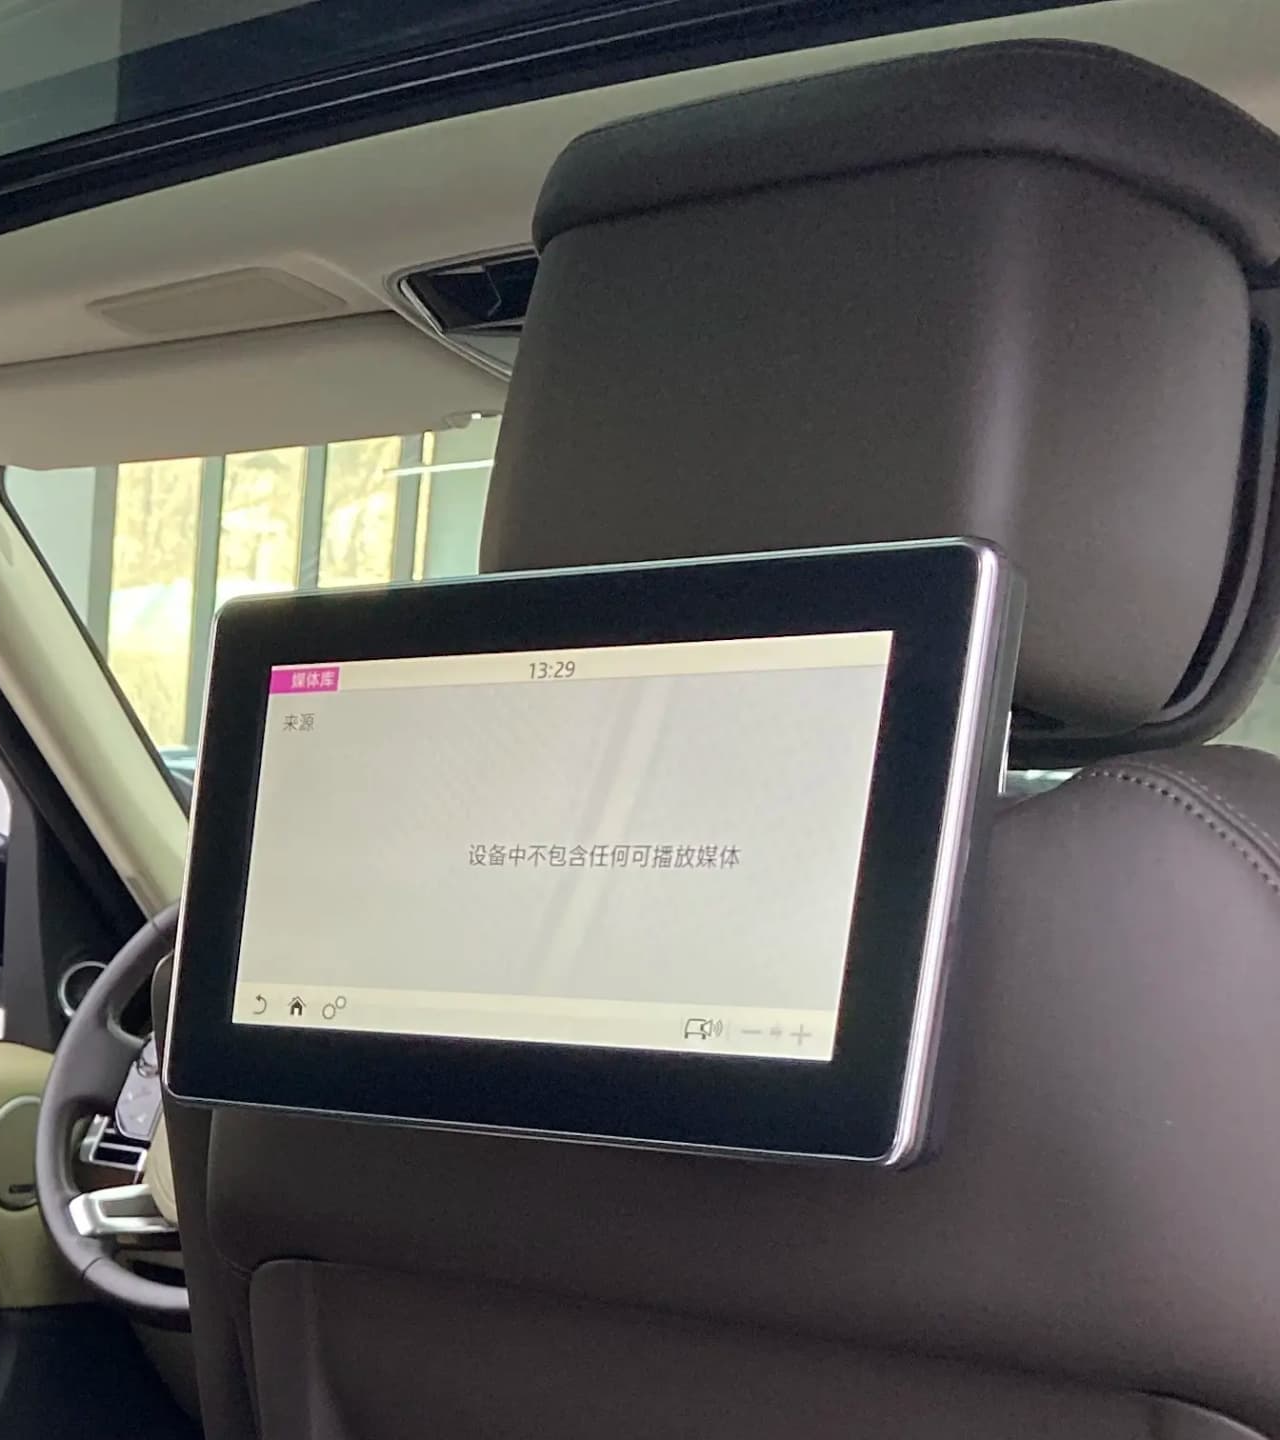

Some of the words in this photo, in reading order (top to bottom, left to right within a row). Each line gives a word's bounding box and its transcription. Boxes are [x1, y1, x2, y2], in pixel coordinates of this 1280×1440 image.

[291, 670, 336, 690] 媒体库
[528, 660, 575, 680] 13:29
[283, 712, 316, 732] 来源
[467, 843, 741, 869] 设备中不包含任何可播放媒体
